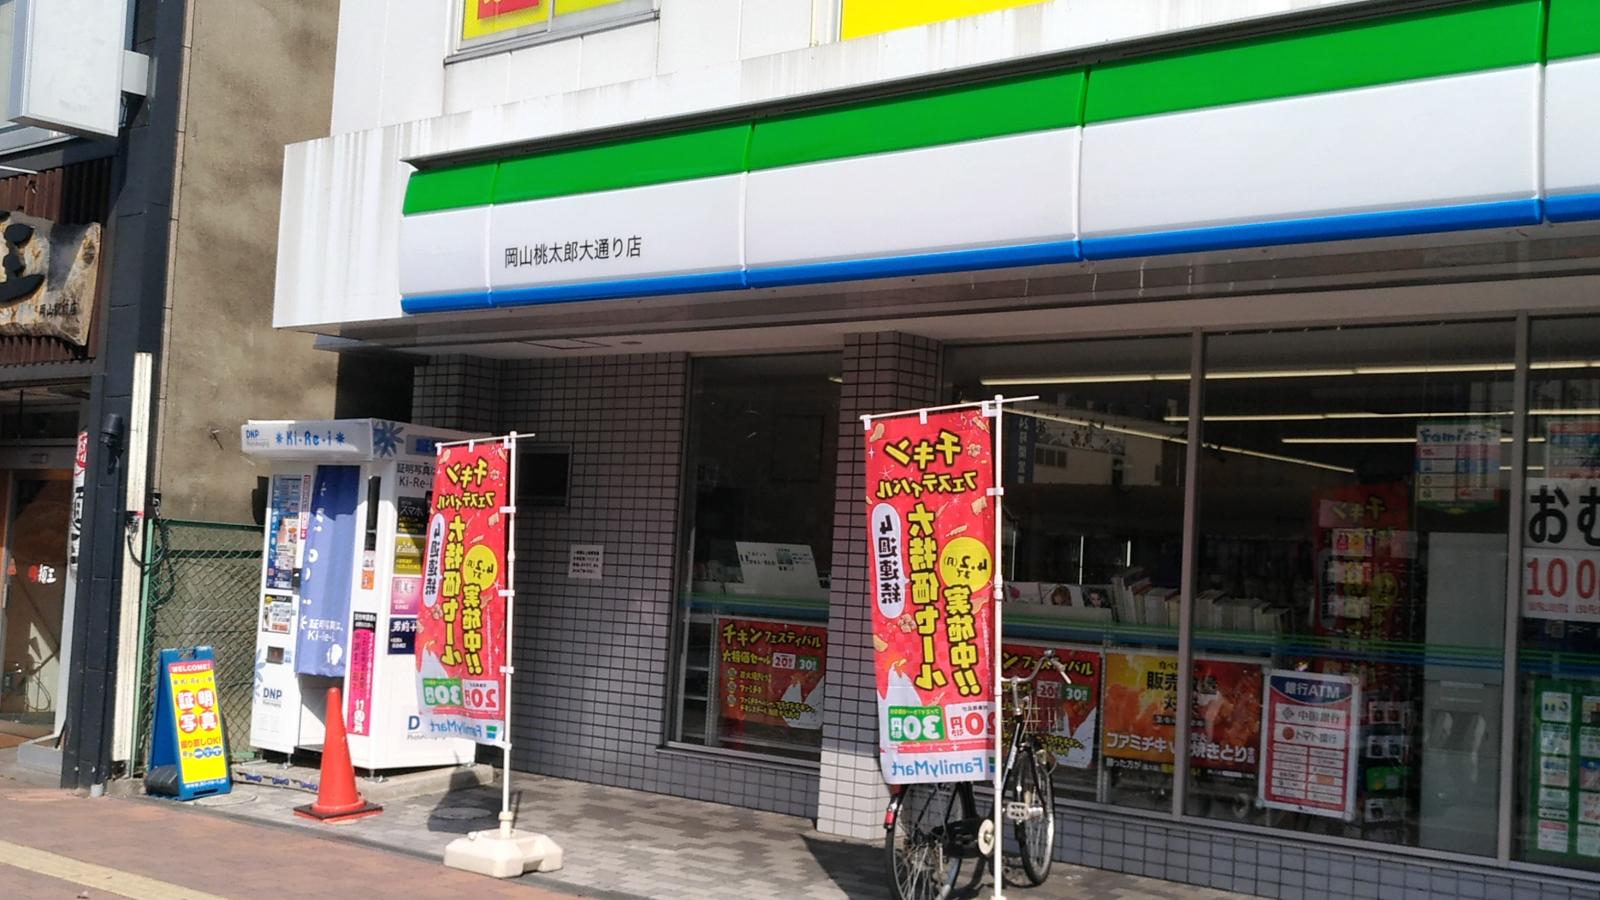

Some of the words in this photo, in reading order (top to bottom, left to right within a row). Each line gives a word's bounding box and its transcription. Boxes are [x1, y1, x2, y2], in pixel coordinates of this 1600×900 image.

[504, 236, 642, 268] 岡山桃太郎大通り店
[246, 430, 259, 439] DNP
[723, 623, 763, 648] チキン
[765, 630, 822, 648] フェスティバル
[722, 649, 772, 665] 大特価セール
[171, 663, 211, 673] WELCOME!
[263, 687, 282, 698] DNP
[1284, 680, 1341, 699] 銀行ATM
[1297, 710, 1341, 725] 中国銀行
[1106, 732, 1167, 752] ファミチキ
[1296, 728, 1337, 744] トマト銀行
[1191, 742, 1248, 763] 焼きとり
